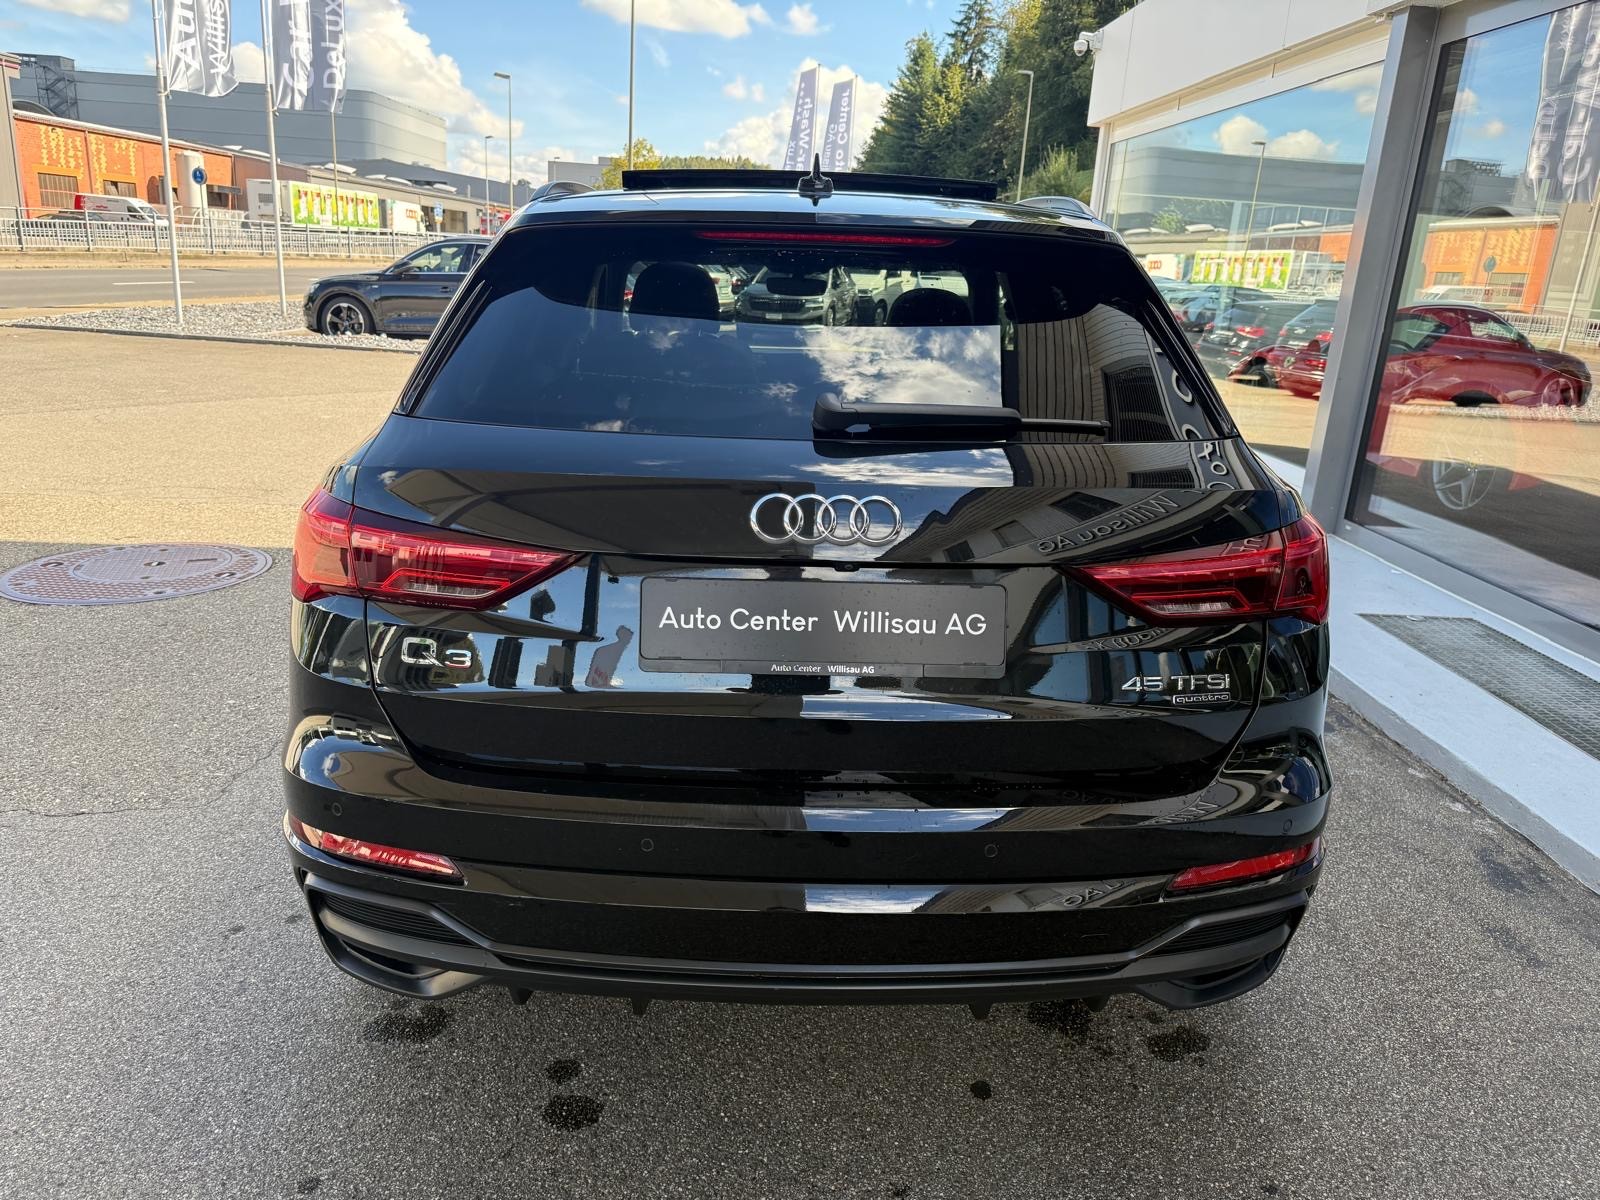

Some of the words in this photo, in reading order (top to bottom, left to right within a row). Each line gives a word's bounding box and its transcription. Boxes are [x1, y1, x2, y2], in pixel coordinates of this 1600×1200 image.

[206, 0, 226, 74] Willis
[658, 606, 721, 630] Auto
[730, 608, 818, 632] Center
[833, 610, 937, 635] Willisau
[945, 613, 987, 636] AG
[401, 637, 472, 669] Q3
[770, 663, 792, 672] Auto
[793, 664, 821, 673] Center
[827, 665, 861, 674] Willisau
[862, 666, 875, 674] AG
[1121, 676, 1164, 691] 45
[1170, 674, 1230, 690] TFSI
[1176, 694, 1229, 704] quattro
